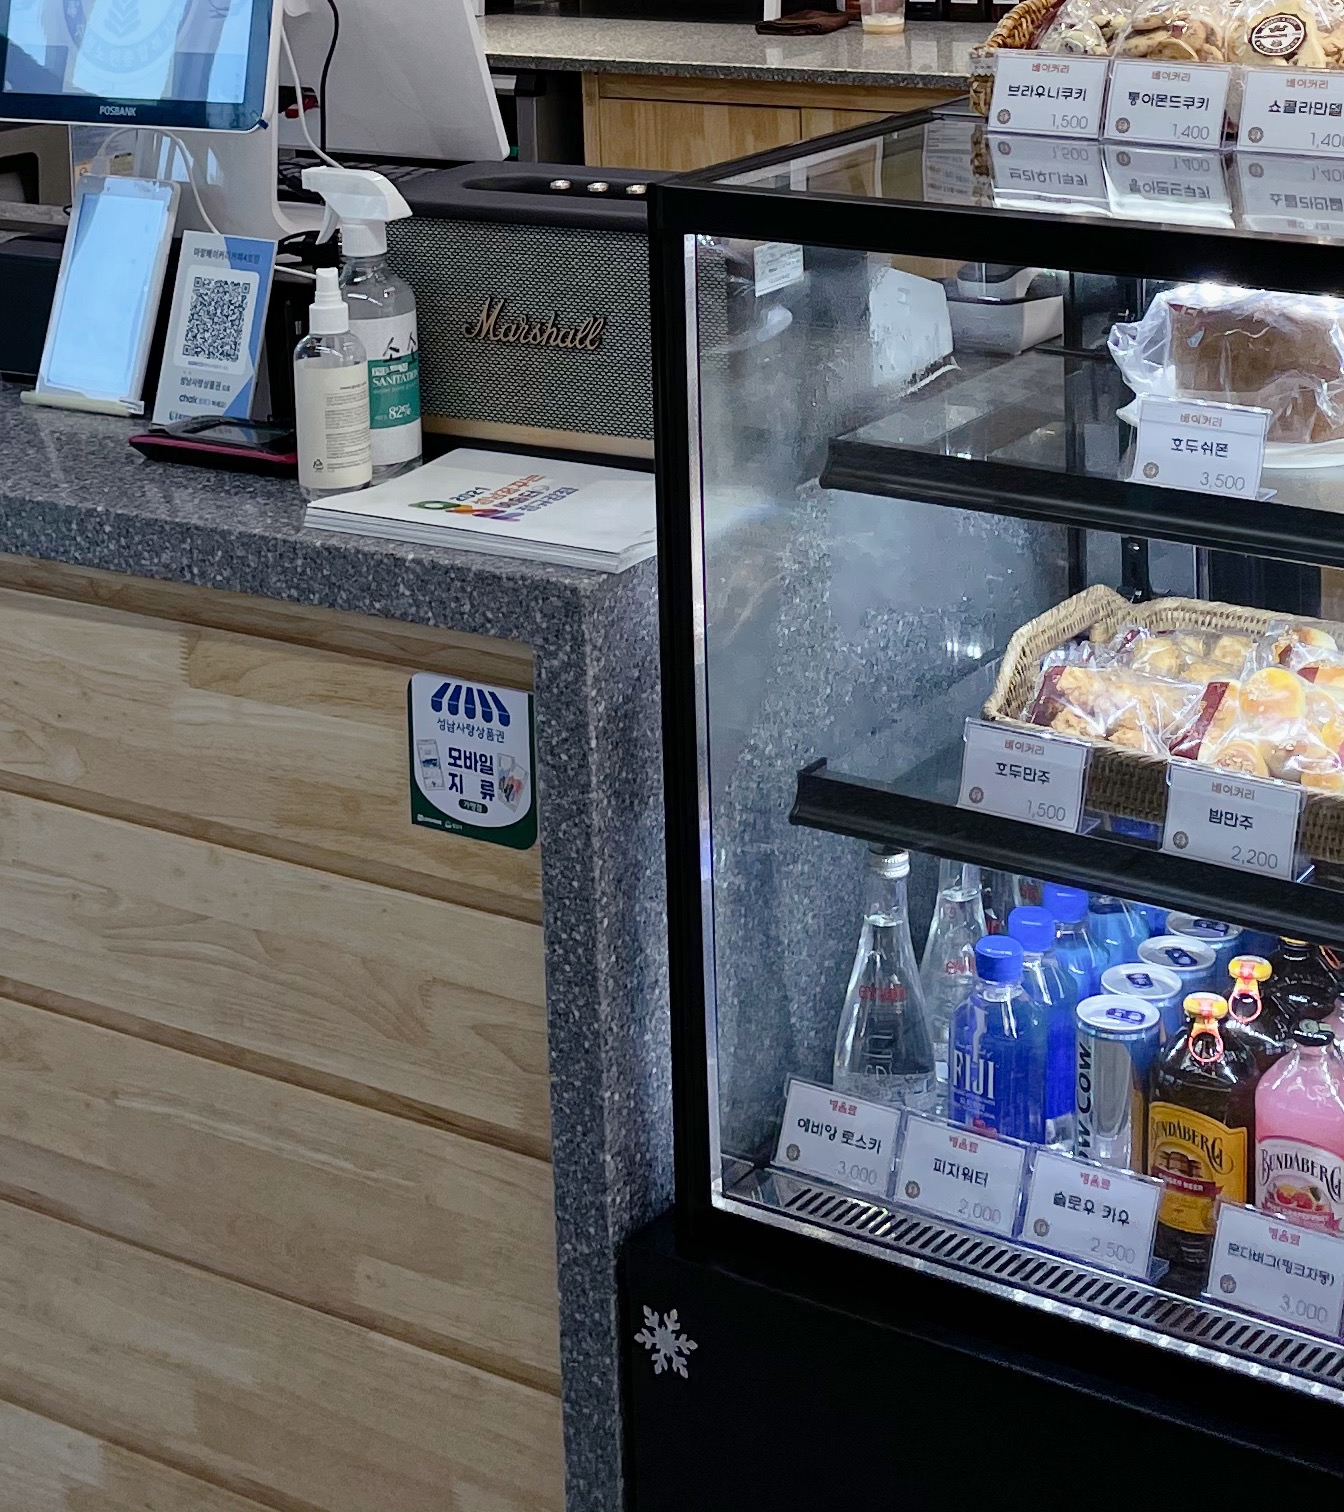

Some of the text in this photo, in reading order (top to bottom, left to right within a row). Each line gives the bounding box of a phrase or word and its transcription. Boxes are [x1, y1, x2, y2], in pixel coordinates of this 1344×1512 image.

[1007, 83, 1088, 104] 브라우니쿠키
[99, 105, 136, 117] POSBANK
[1050, 113, 1089, 131] 1,500
[1171, 123, 1210, 142] 1,400
[462, 295, 606, 354] Marshall
[1170, 436, 1230, 460] 호두쉬폰
[1199, 471, 1246, 492] 3,500
[437, 717, 505, 744] 성남사랑상품권
[447, 747, 494, 776] 모바일
[995, 760, 1052, 786] 호두만주
[448, 772, 495, 802] 지 류
[1026, 799, 1067, 822] 1,500
[1208, 807, 1255, 831] 밤만주
[1231, 845, 1279, 870] 2,200
[954, 1049, 995, 1099] FIJI
[1078, 1041, 1093, 1115] COW
[797, 1117, 838, 1142] 에비앙
[837, 1159, 878, 1186] 3,000
[933, 1157, 989, 1189] 피지워터
[1260, 1147, 1343, 1200] BUNDABERG
[957, 1197, 1002, 1224] 2,000
[1102, 1204, 1131, 1227] 카우
[1090, 1237, 1137, 1265] 2,500
[1279, 1293, 1329, 1322] 3,000
